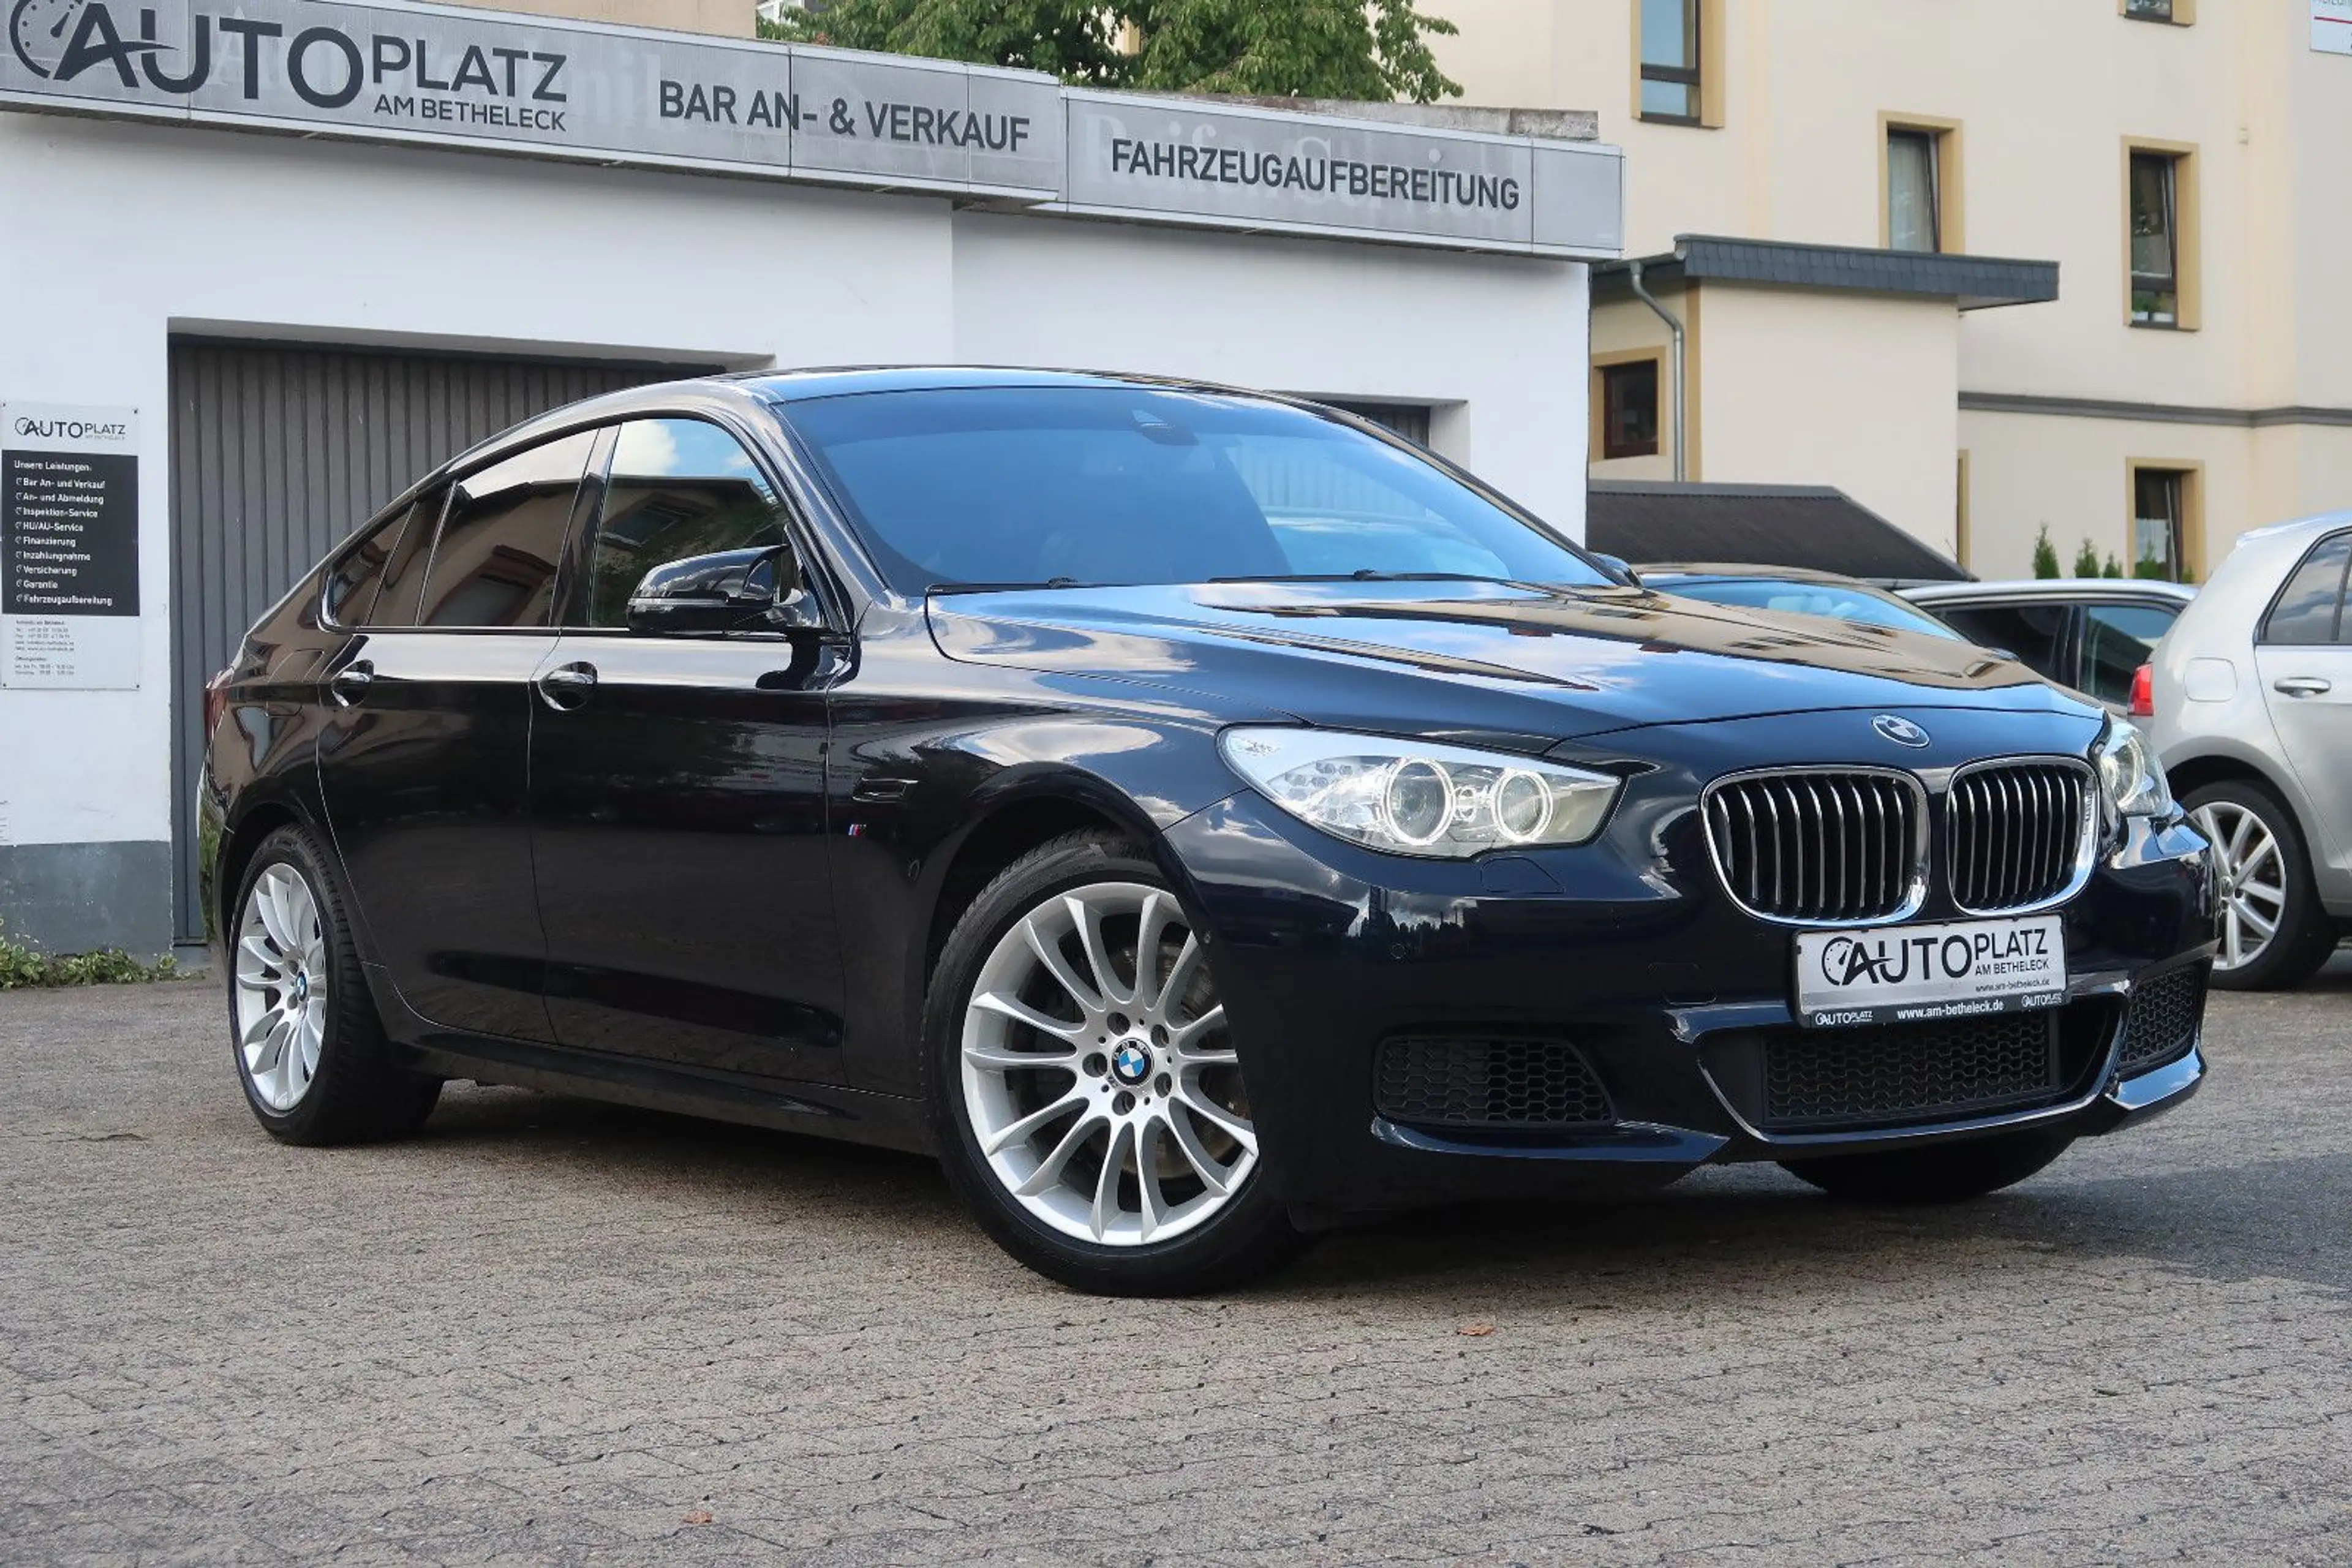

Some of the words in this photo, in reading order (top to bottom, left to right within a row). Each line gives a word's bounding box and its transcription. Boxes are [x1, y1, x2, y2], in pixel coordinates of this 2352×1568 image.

[374, 93, 415, 117] AM
[422, 97, 567, 132] BETHELECK
[660, 80, 737, 124] BAR
[747, 90, 817, 130] AN-
[829, 99, 856, 137] &
[865, 101, 1030, 152] VERKAUF
[1112, 138, 1520, 211] FAHRZEUGAUFBEREITUNG
[14, 460, 43, 470] Unsere
[23, 478, 38, 486] Bar
[40, 478, 55, 488] An-
[57, 479, 72, 488] und
[74, 480, 105, 489] Verkauf
[23, 492, 38, 501] An-
[40, 494, 55, 502] und
[57, 494, 104, 505] Abmeldung
[23, 537, 76, 547] Finanzierung
[23, 551, 91, 562] Inzahlungnahme
[23, 565, 77, 576] Versicherung
[23, 580, 58, 589] Garantie
[23, 594, 113, 606] Fahrzeugaufbereitung
[1975, 963, 1991, 976] AM
[1994, 959, 2050, 975] BETHELECK
[1898, 998, 2004, 1020] www.am-betheleck.de
